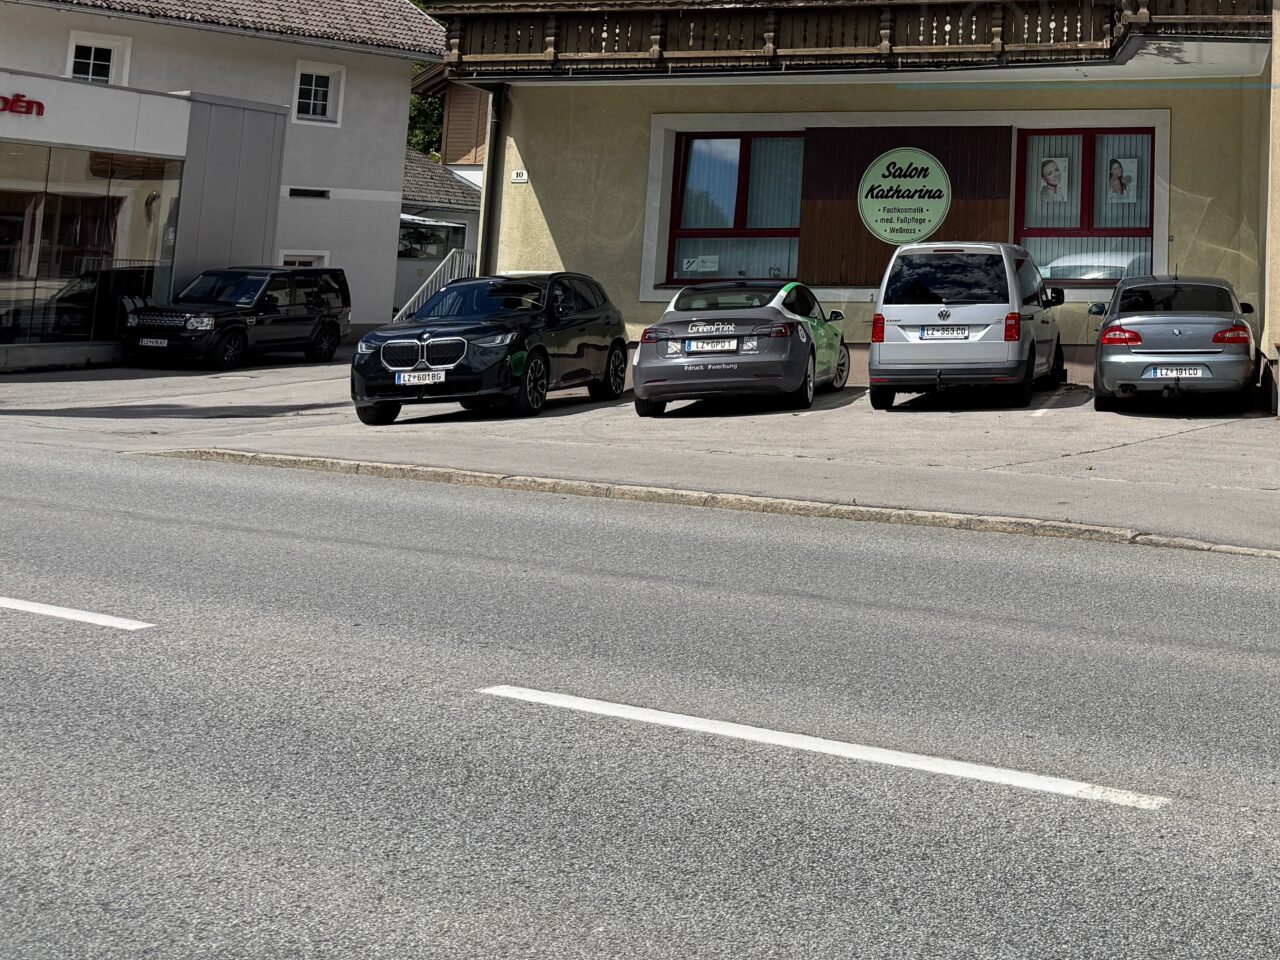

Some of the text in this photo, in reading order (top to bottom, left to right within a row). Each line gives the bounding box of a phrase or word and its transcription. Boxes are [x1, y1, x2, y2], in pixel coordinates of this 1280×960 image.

[516, 171, 524, 179] 10
[881, 161, 930, 179] Salon
[864, 184, 945, 200] Katharina
[882, 206, 924, 214] Fachkosmetik
[688, 322, 736, 333] GreenPrint
